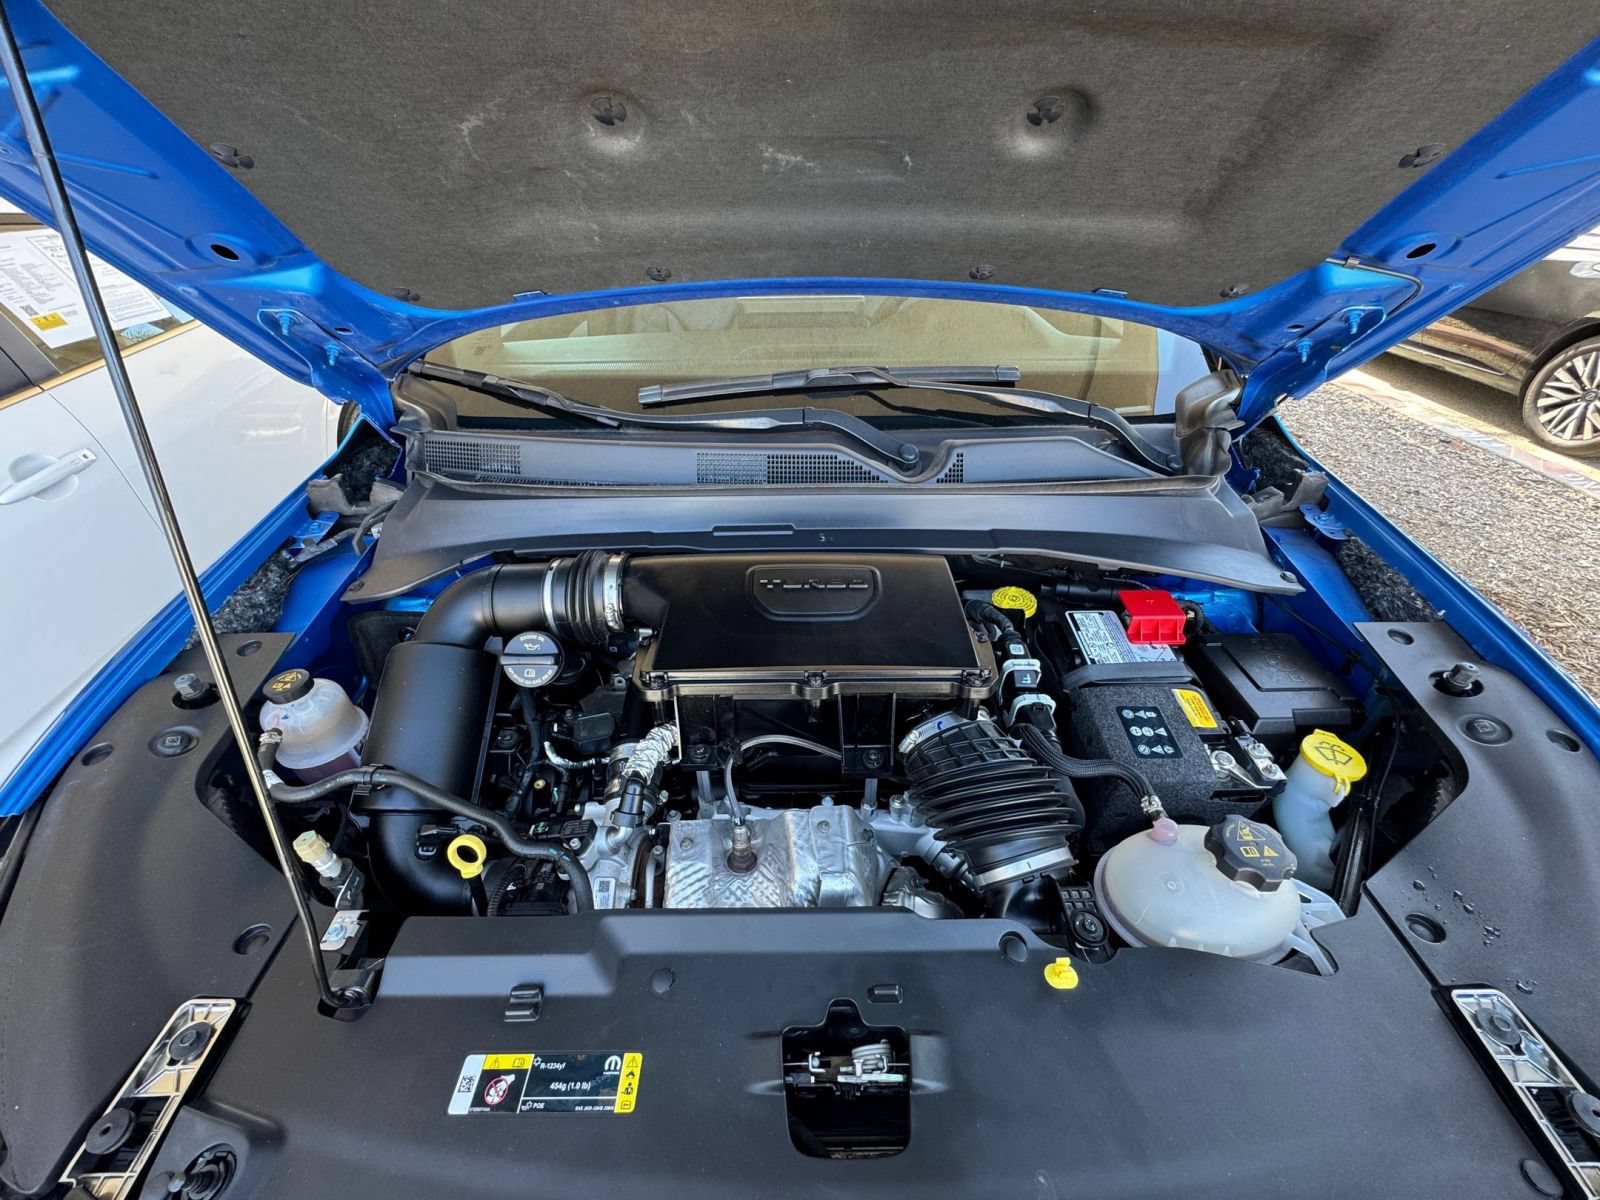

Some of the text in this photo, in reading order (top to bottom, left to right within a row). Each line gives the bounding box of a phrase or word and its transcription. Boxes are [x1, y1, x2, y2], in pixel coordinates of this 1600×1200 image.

[540, 1062, 566, 1071] R-1234yf
[549, 1081, 592, 1092] 454g (1.0 lb)
